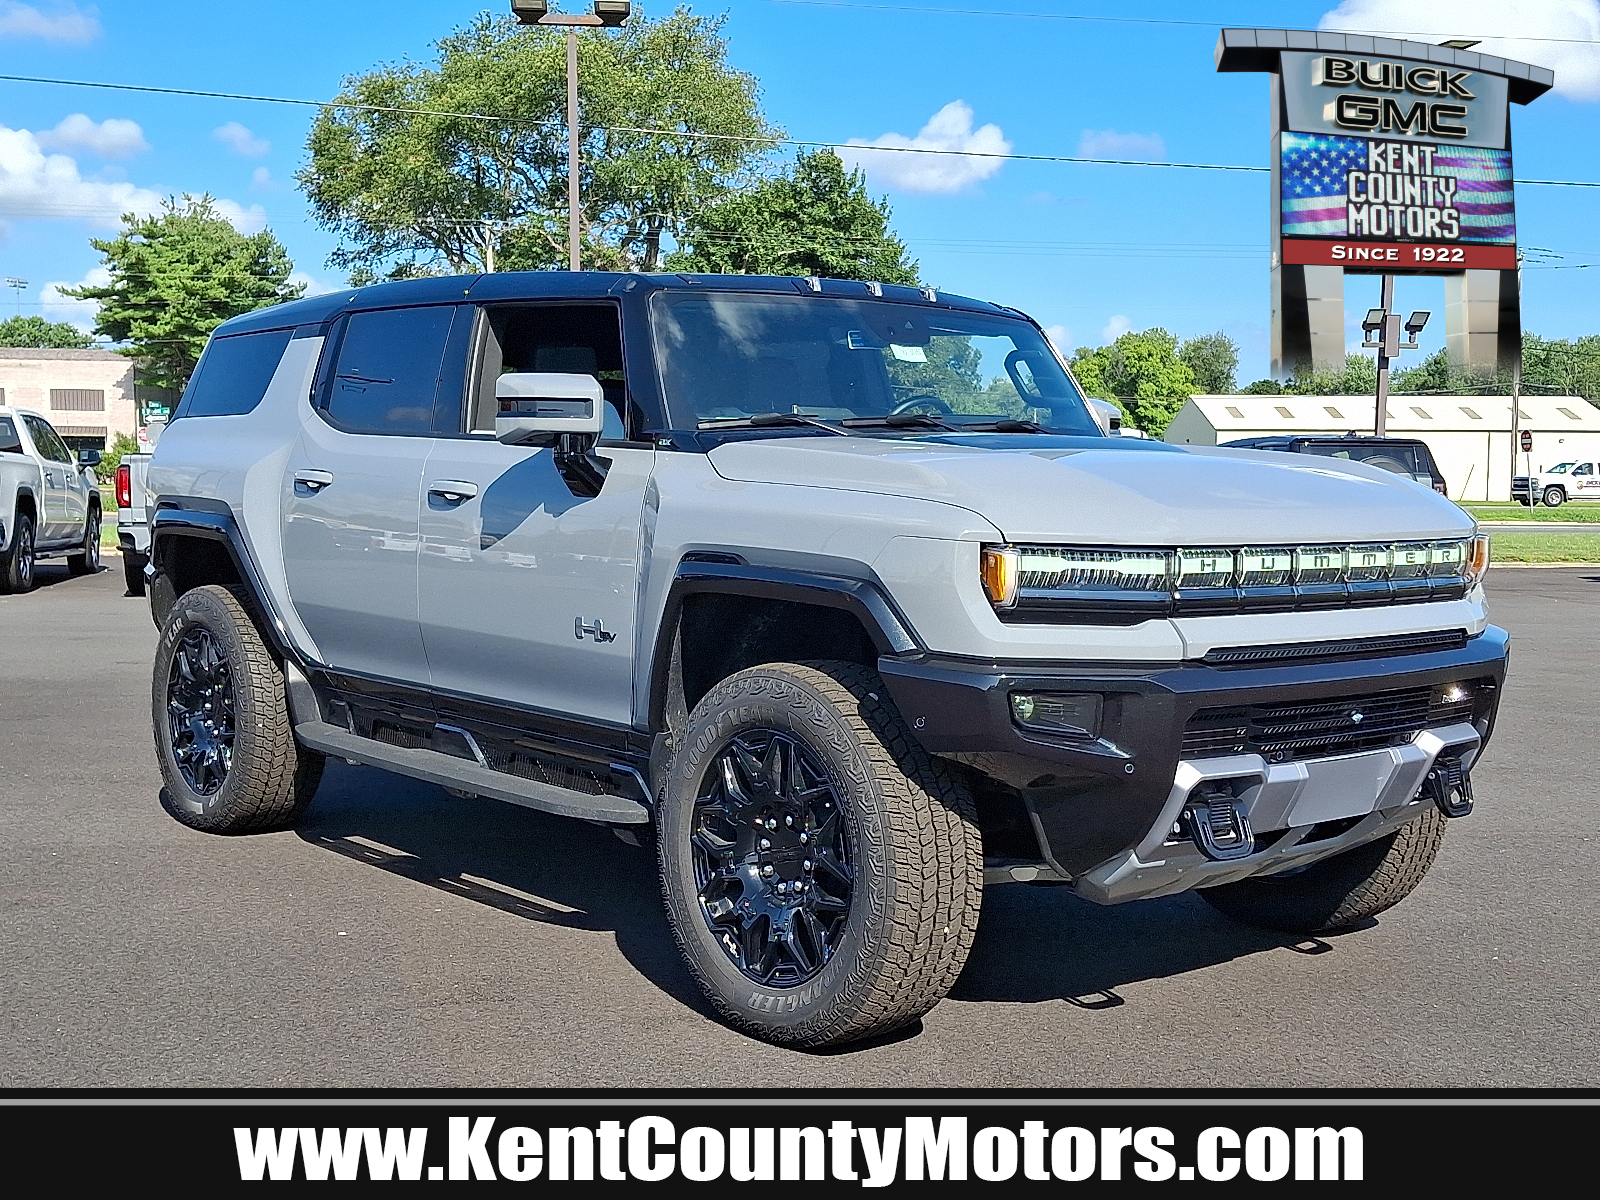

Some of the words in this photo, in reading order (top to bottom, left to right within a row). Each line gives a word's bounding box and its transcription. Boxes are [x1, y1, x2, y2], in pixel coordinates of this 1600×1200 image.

[1323, 55, 1477, 98] BUICK
[1335, 93, 1469, 137] GMC
[1368, 141, 1437, 176] KENT
[1348, 171, 1457, 208] COUNTY
[1348, 202, 1460, 239] MOTORS
[1331, 245, 1400, 261] SINCE
[1413, 247, 1466, 263] 1922
[1200, 550, 1452, 572] HUMMER
[683, 705, 776, 779] GOODYEAR
